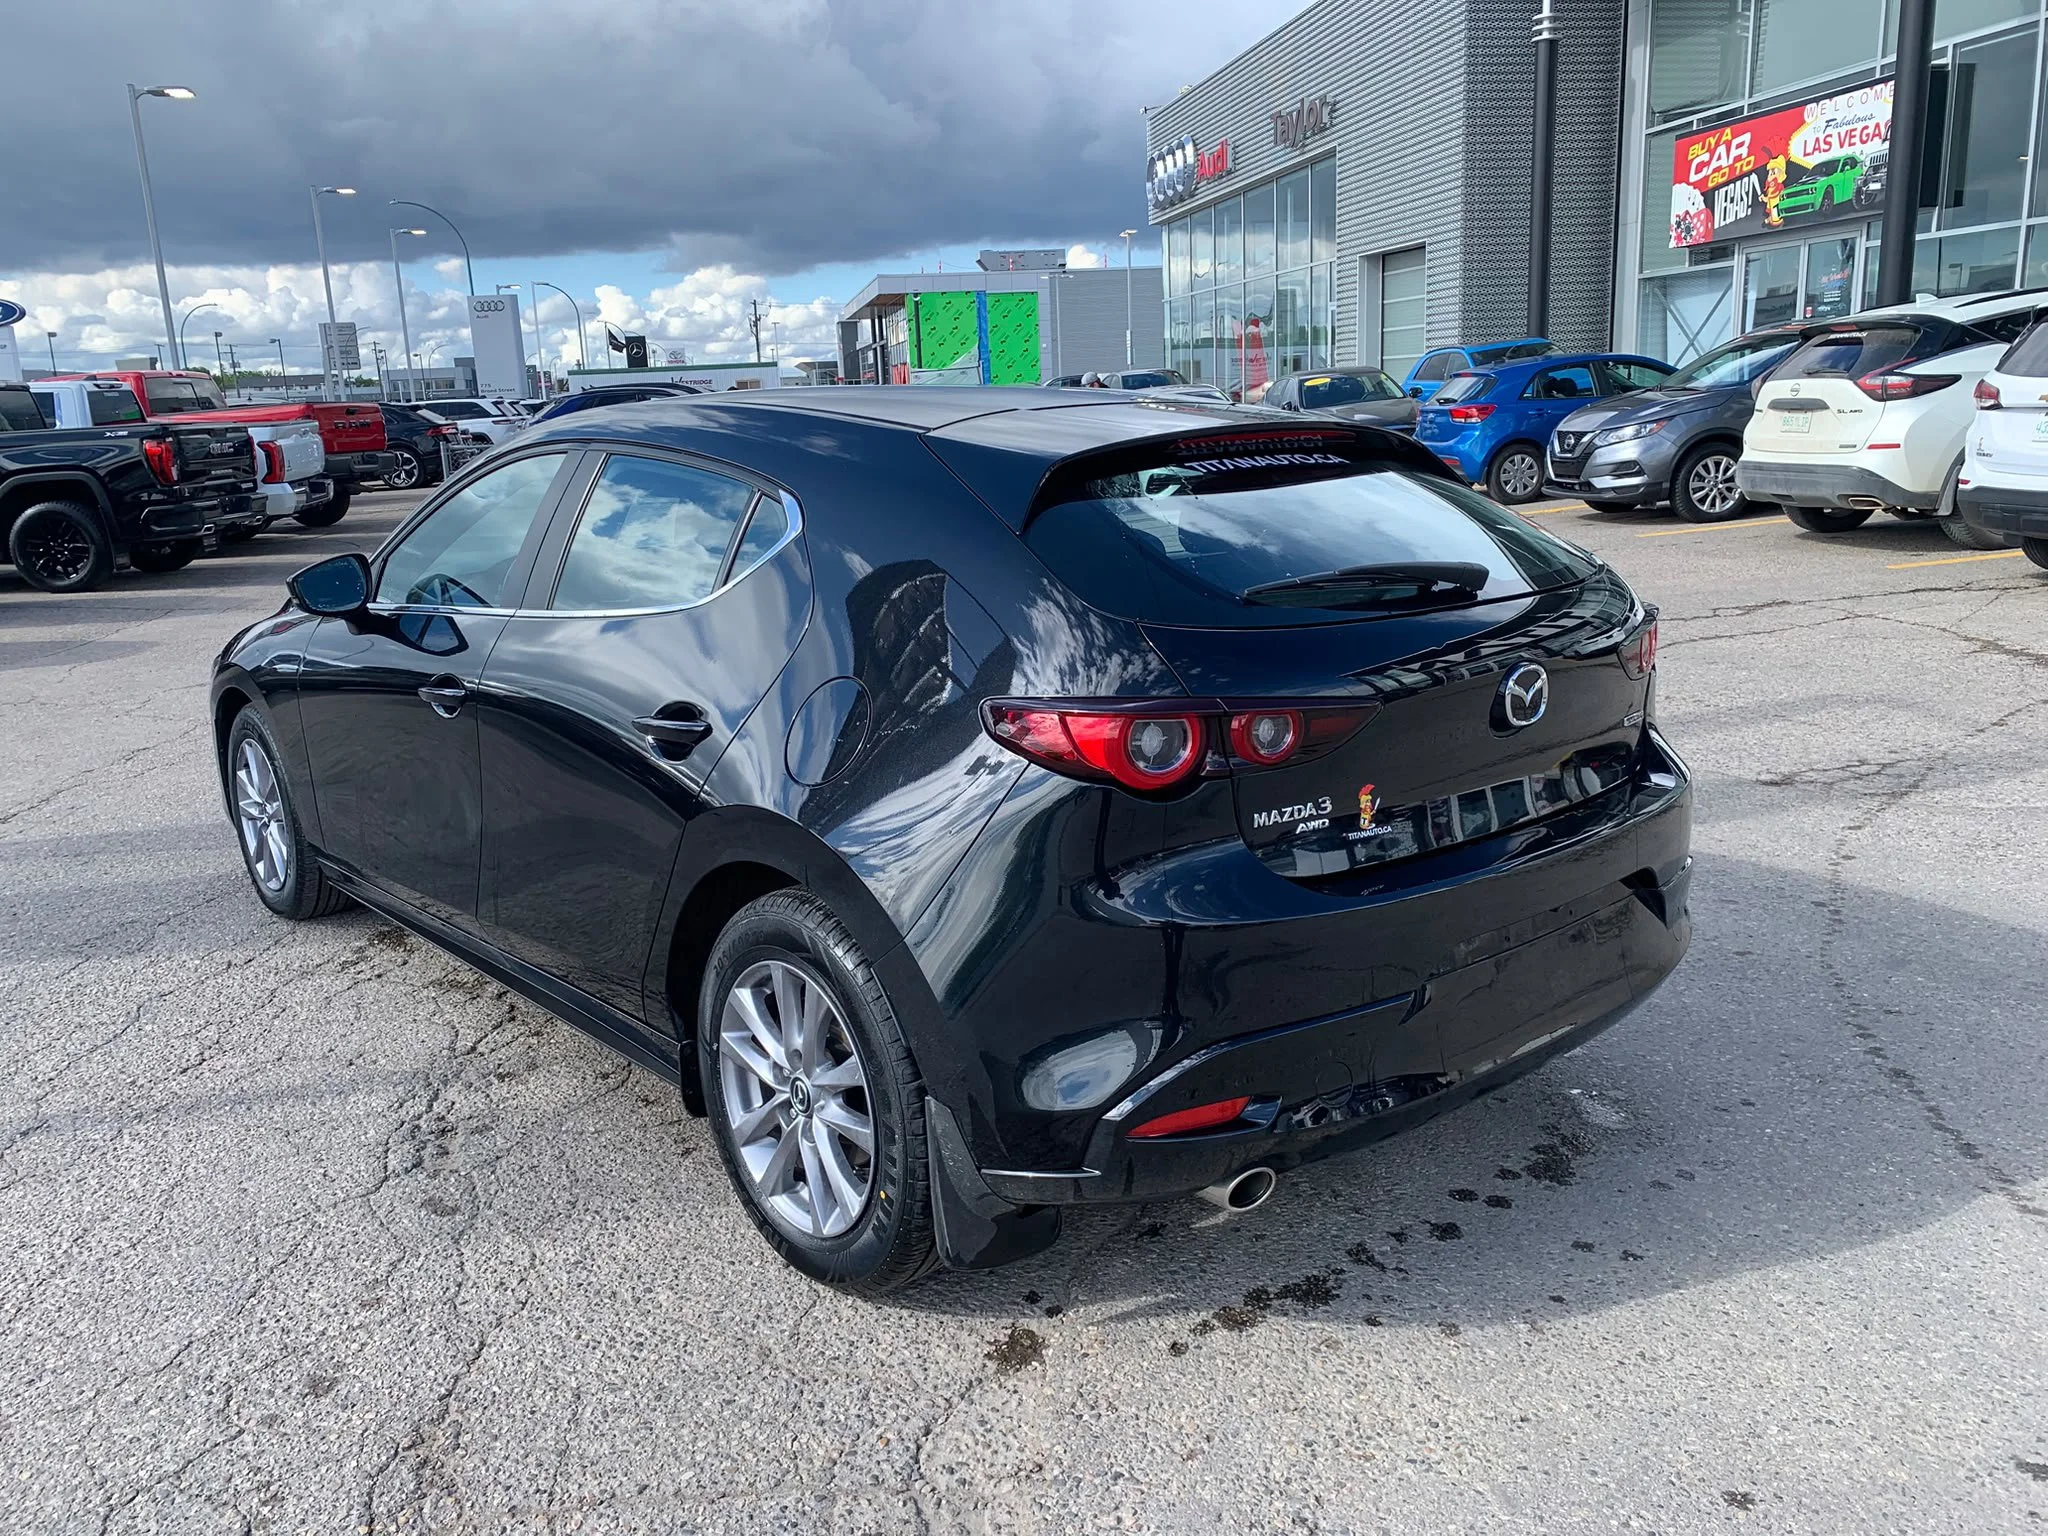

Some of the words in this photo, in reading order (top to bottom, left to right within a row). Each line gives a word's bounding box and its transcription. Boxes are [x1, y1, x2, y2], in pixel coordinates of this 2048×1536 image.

[1806, 83, 1894, 120] WELCOME
[1270, 94, 1333, 149] Taylor
[1822, 112, 1877, 135] Fabulous
[1688, 134, 1719, 160] BUY
[1719, 127, 1732, 145] A
[1689, 132, 1752, 183] CAR
[1802, 136, 1833, 158] LAS
[1196, 137, 1234, 184] Audi
[1707, 167, 1730, 188] GO
[1734, 155, 1755, 175] TO
[1713, 175, 1754, 230] VEGAS!
[333, 419, 371, 429] RAM
[209, 442, 235, 455] GMC
[1184, 453, 1351, 473] TITANAUTO.CA
[1253, 796, 1333, 829] MAZDA3
[1295, 818, 1330, 834] AWD
[1348, 825, 1393, 841] TITANAUTO.CA
